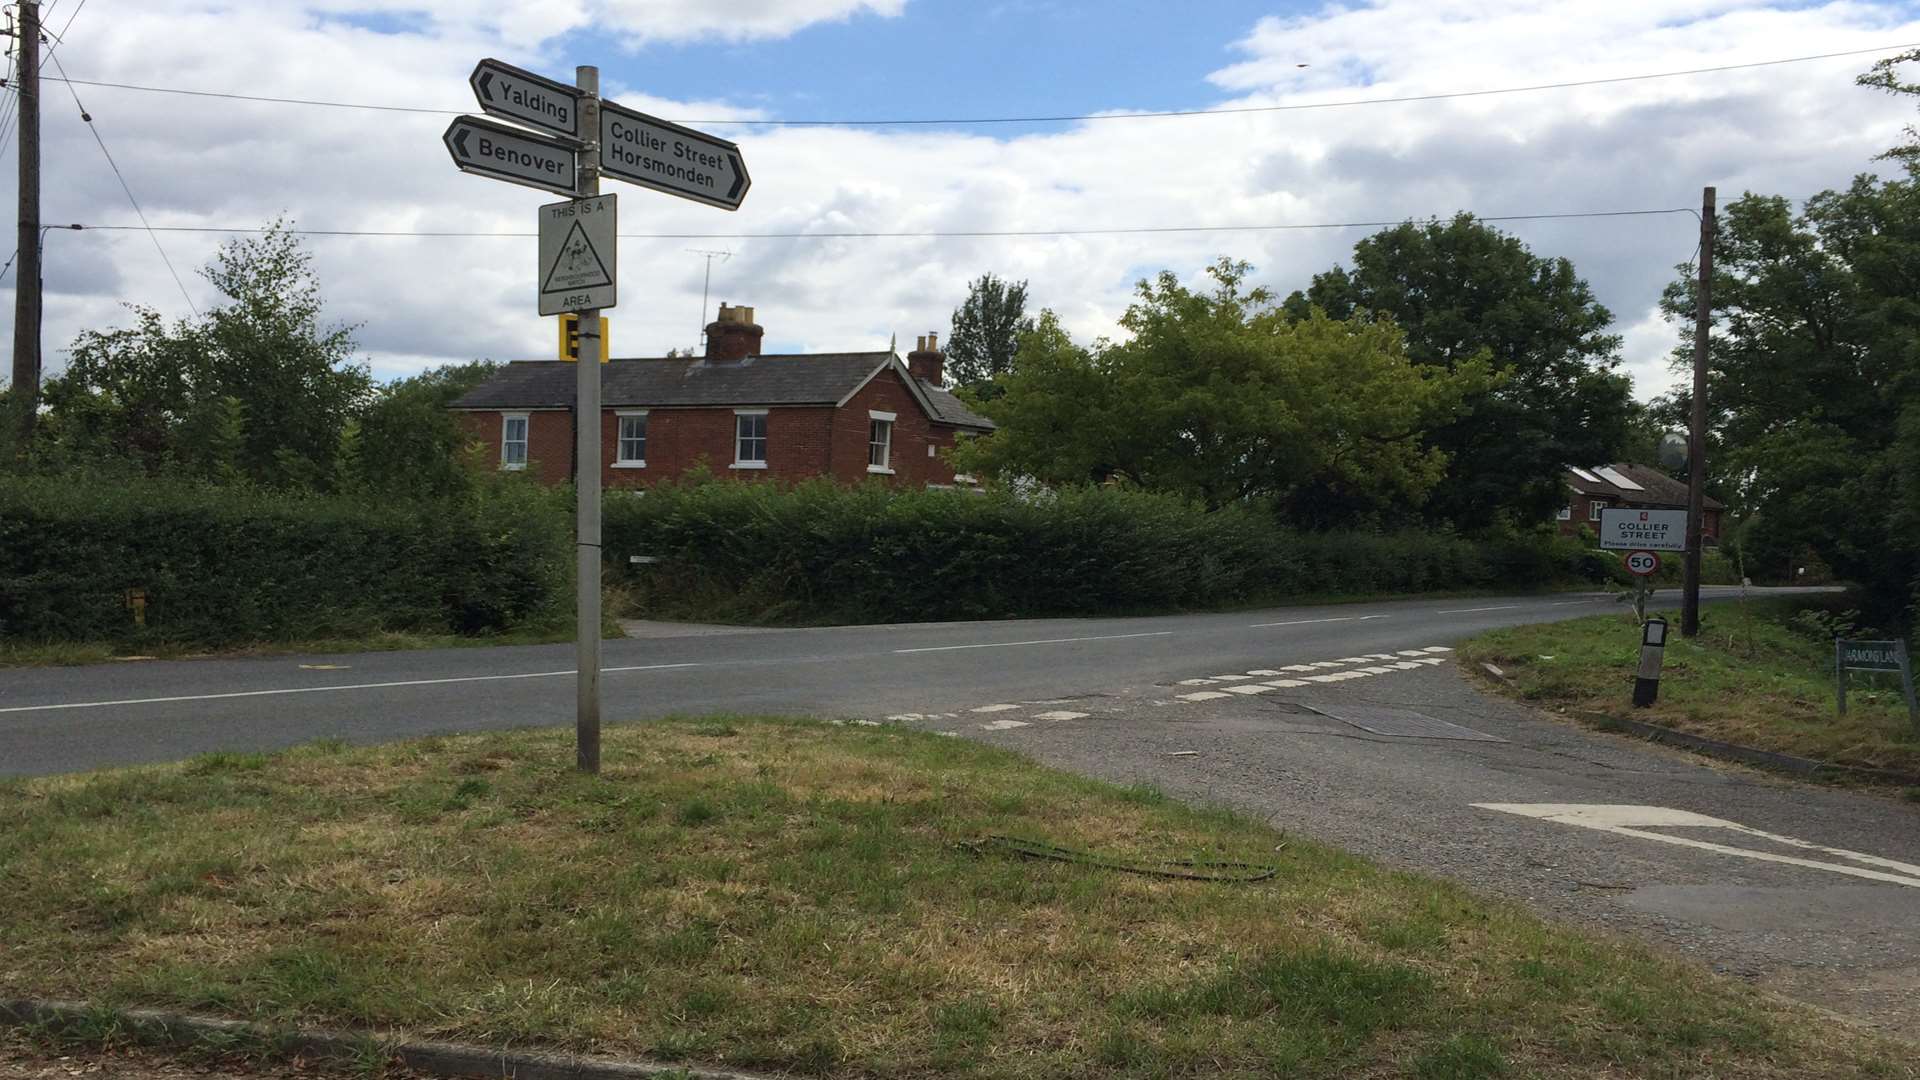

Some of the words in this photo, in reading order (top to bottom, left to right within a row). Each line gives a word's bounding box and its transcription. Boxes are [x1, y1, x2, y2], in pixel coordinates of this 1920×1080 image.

[500, 81, 568, 123] Yalding
[611, 122, 667, 153] Collier
[673, 142, 724, 171] Street
[479, 138, 565, 175] Benover
[611, 143, 715, 188] Horsmonden
[552, 206, 575, 219] THIS
[581, 203, 591, 216] IS
[597, 201, 604, 213] A
[562, 294, 592, 308] AREA
[1618, 522, 1669, 531] COLLIER
[1621, 531, 1667, 540] STREET
[1631, 557, 1654, 568] 50
